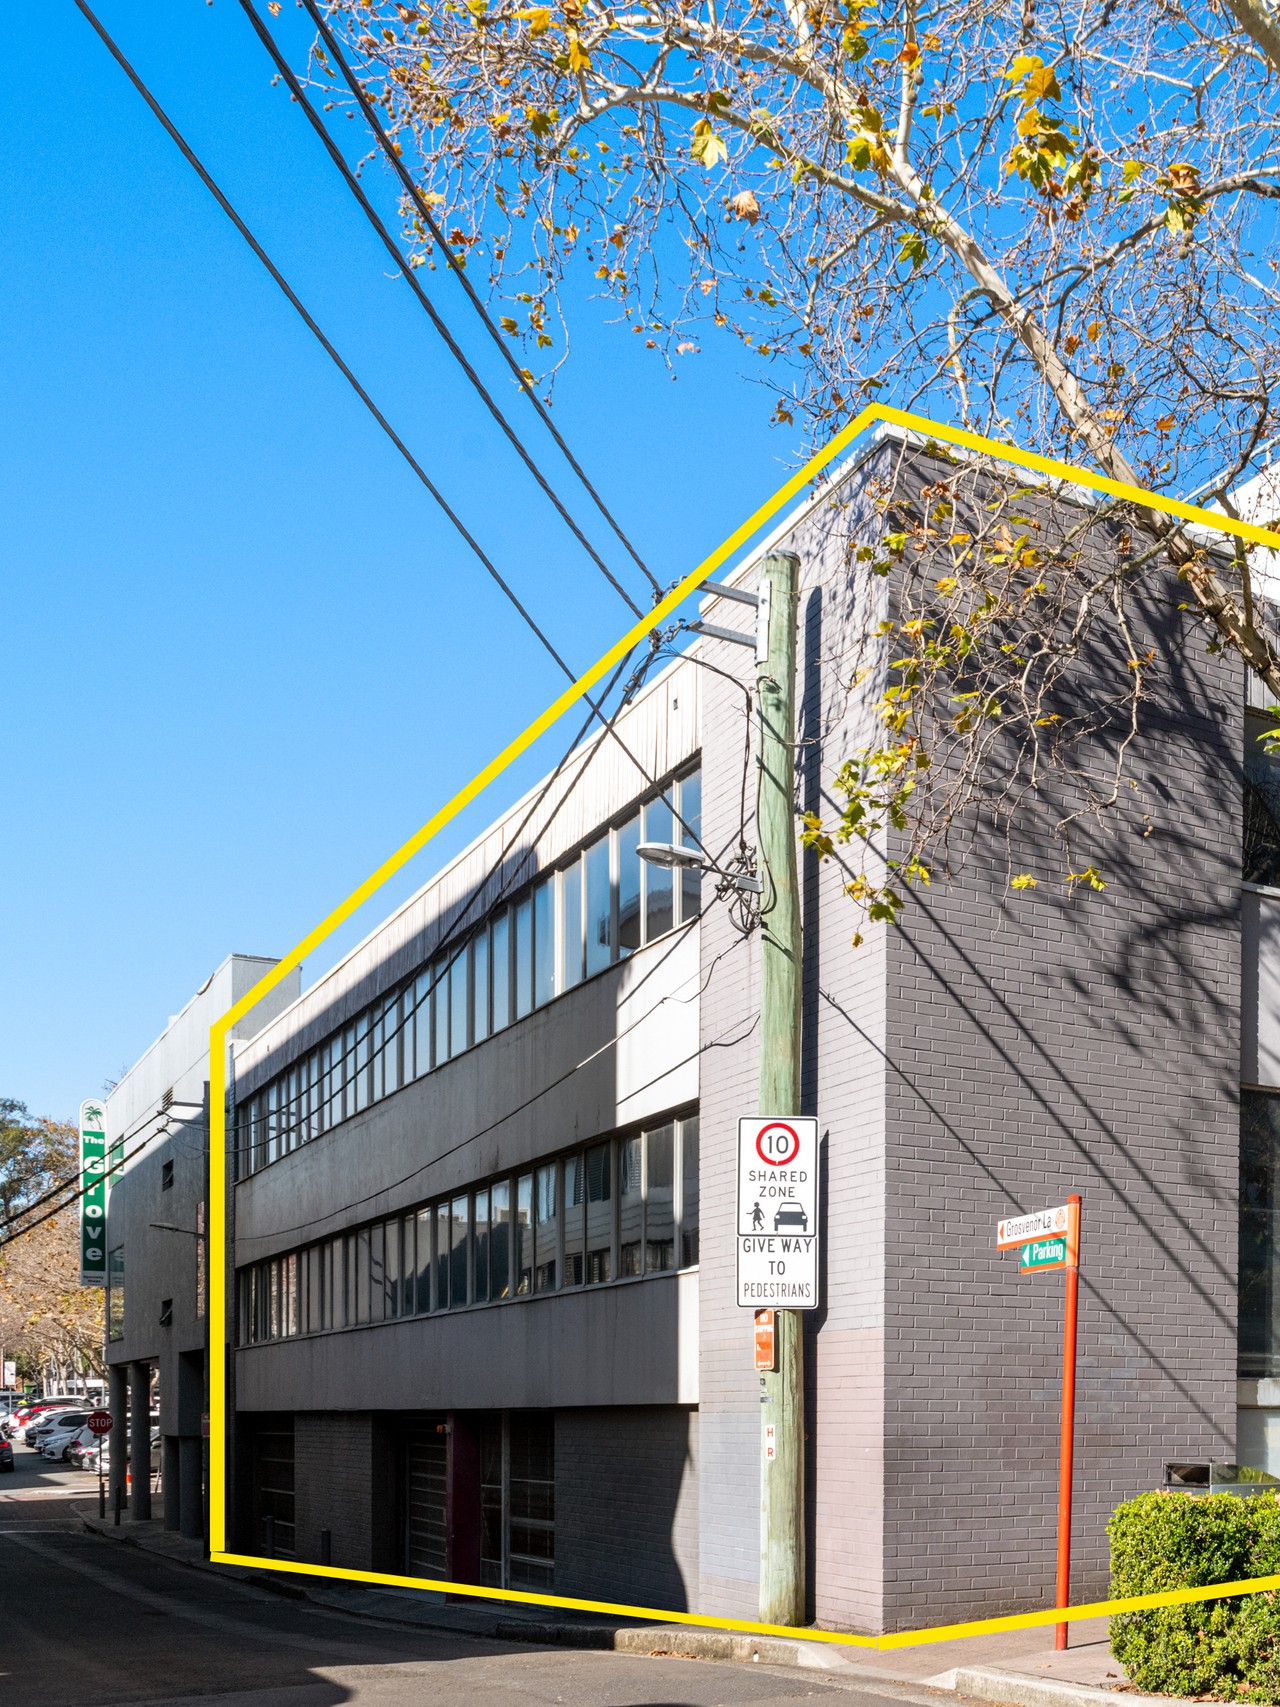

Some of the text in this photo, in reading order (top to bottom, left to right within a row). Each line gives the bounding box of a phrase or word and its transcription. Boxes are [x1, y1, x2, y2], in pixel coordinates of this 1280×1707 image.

[83, 1135, 104, 1145] The
[767, 1135, 789, 1154] 10
[749, 1170, 808, 1182] SHARED
[759, 1186, 795, 1198] ZONE
[83, 1156, 104, 1261] Grove
[1006, 1213, 1051, 1237] Grosvenor La
[743, 1238, 812, 1253] GIVE WAY
[1033, 1241, 1063, 1260] Parking
[768, 1260, 785, 1275] TO
[744, 1283, 811, 1298] PEDESTRIANS
[89, 1418, 113, 1428] STOP
[767, 1427, 774, 1457] H R
